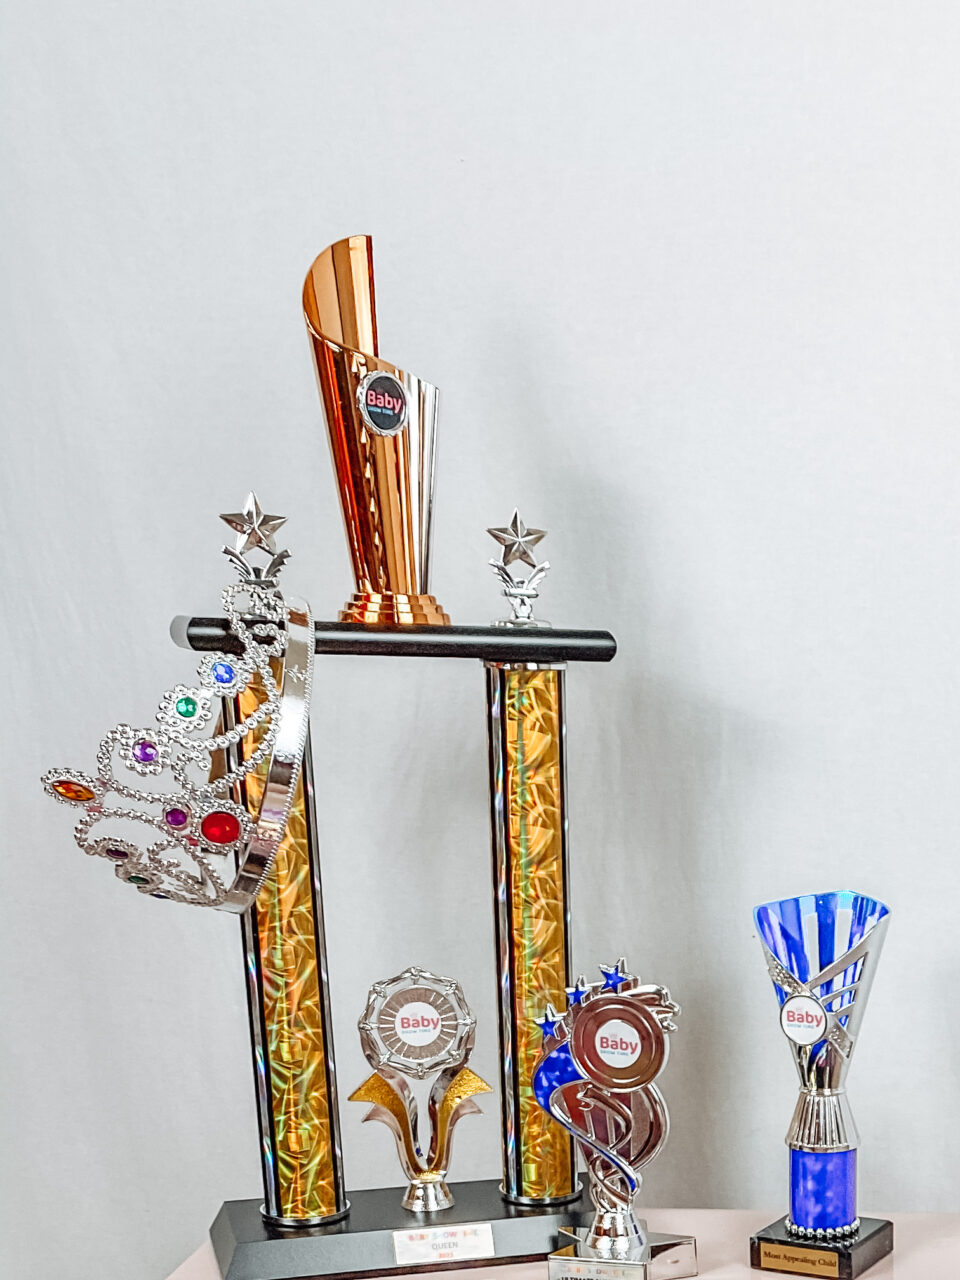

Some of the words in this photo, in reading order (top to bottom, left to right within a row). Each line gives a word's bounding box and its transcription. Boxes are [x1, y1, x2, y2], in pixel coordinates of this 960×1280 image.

[367, 390, 401, 413] Baby
[401, 1016, 439, 1029] Baby
[787, 1010, 823, 1027] Baby
[600, 1036, 638, 1054] Baby
[783, 1254, 816, 1266] Appealing
[818, 1258, 837, 1267] Child
